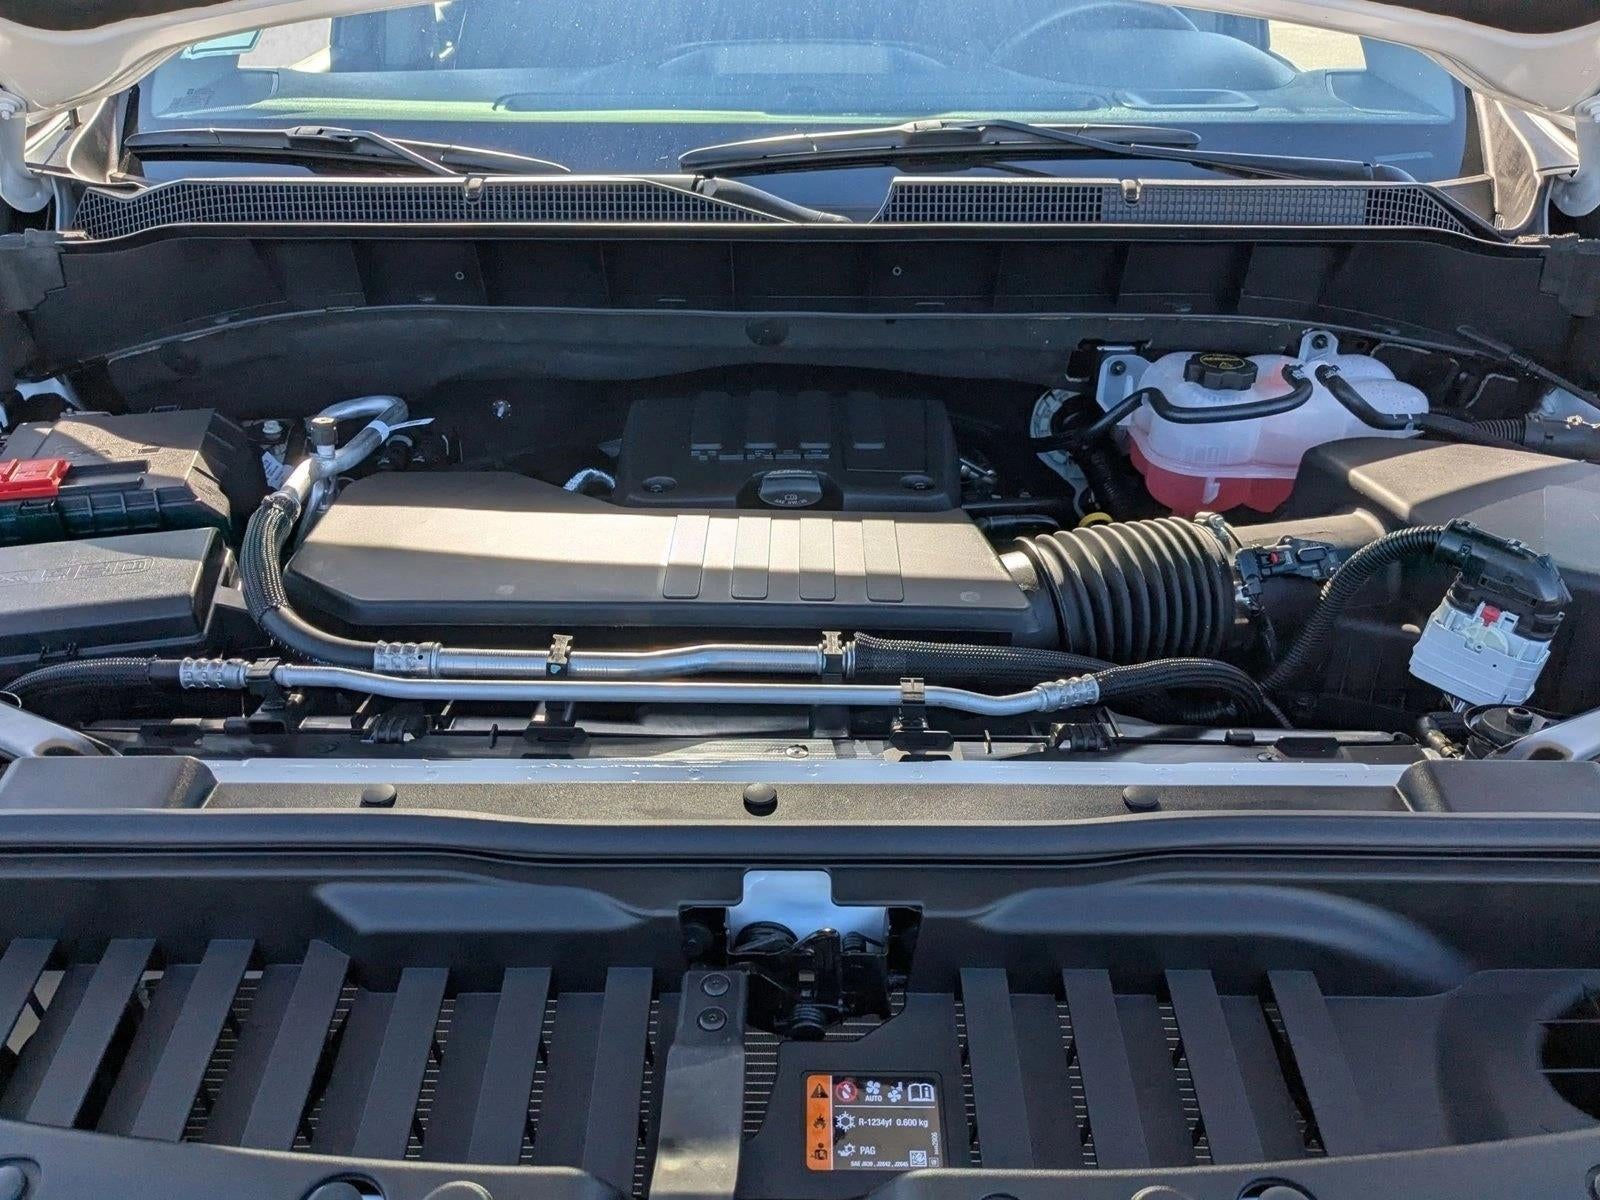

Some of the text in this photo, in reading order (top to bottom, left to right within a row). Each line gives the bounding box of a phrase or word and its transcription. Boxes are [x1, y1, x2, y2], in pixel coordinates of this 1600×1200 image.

[858, 1118, 928, 1128] R-1234yf 0.600 kg
[860, 1146, 876, 1155] PAG
